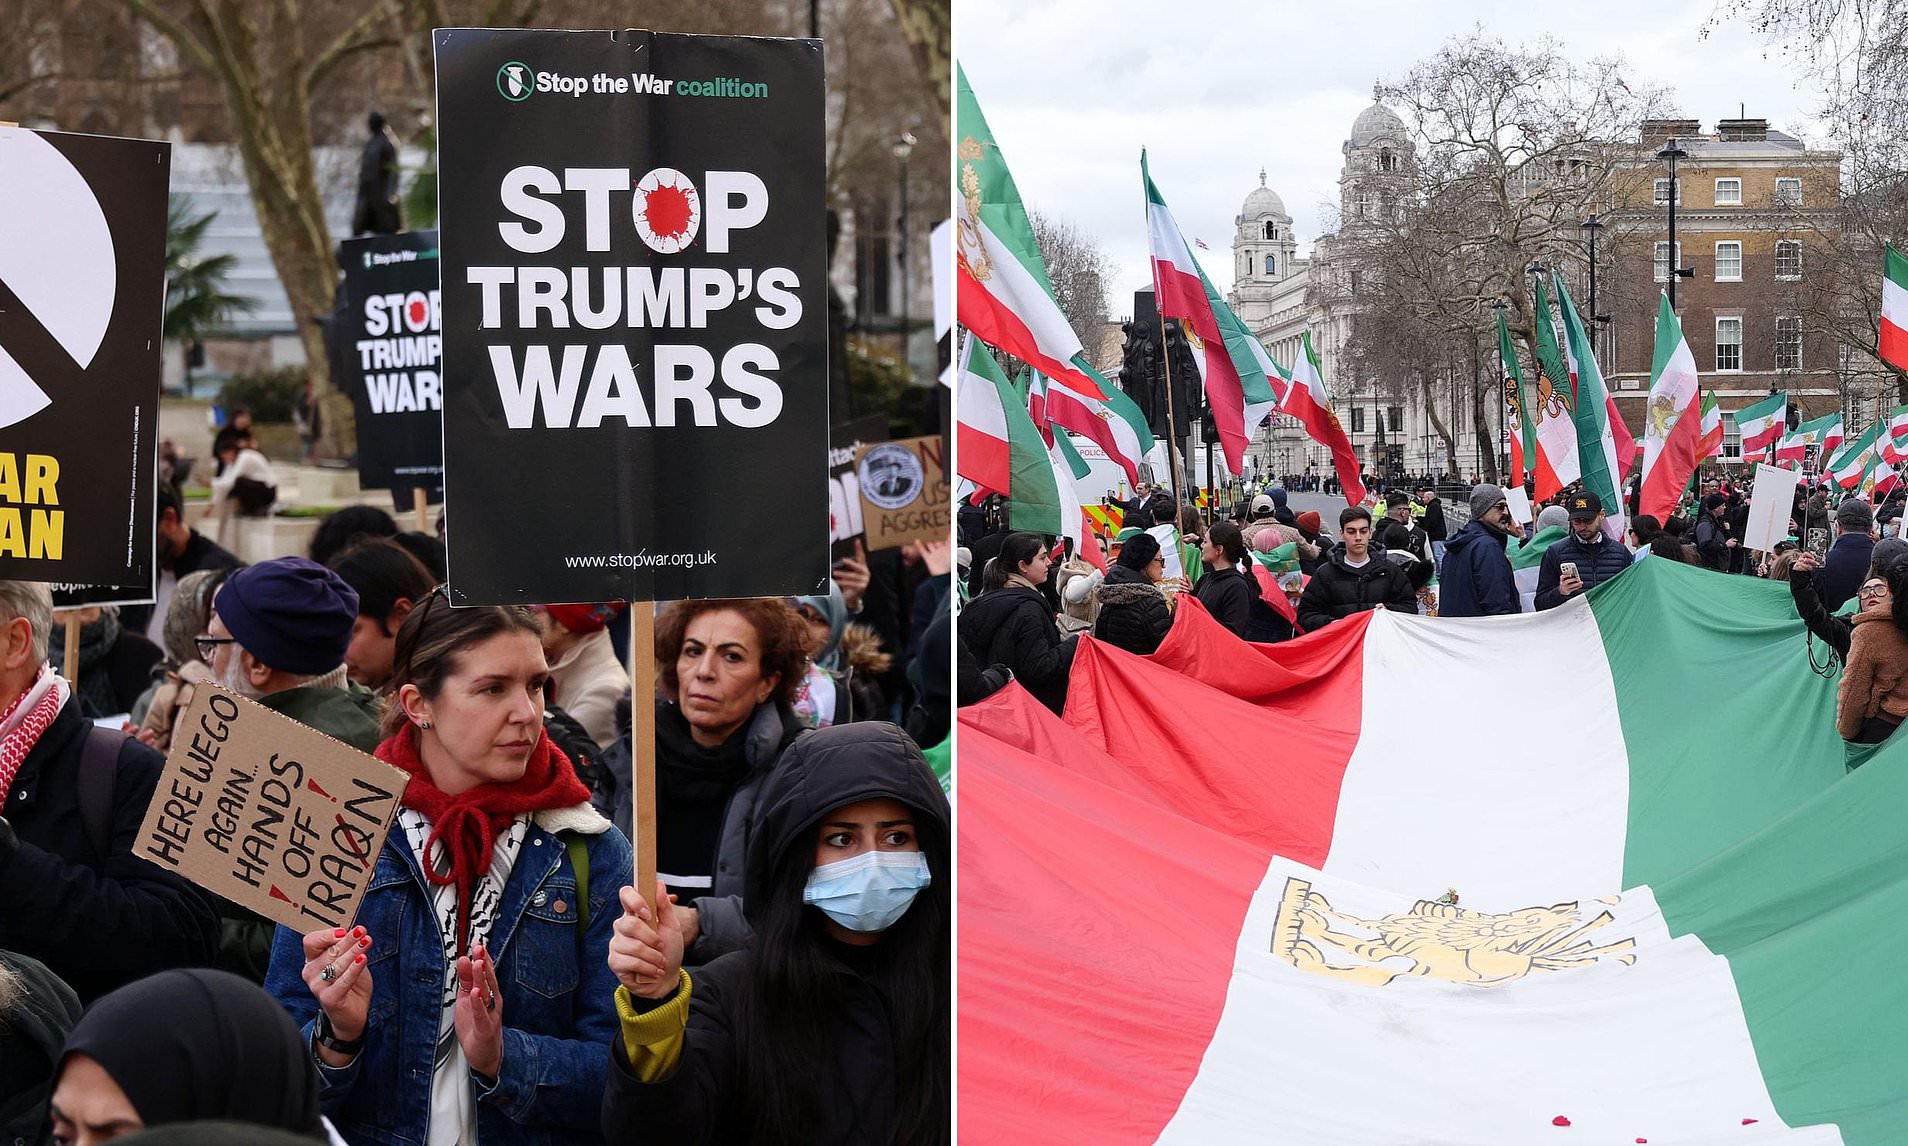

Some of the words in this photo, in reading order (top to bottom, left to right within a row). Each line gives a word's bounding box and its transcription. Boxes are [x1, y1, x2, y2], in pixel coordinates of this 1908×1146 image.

[536, 72, 588, 97] Stop
[592, 74, 628, 93] the
[632, 74, 673, 95] War
[676, 76, 768, 98] coalition
[498, 165, 769, 254] STOP
[467, 266, 803, 329] TRUMP'S
[365, 370, 442, 414] WAR
[487, 343, 784, 429] WARS
[0, 507, 65, 560] AN
[565, 550, 717, 570] www.stopwar.org.uk
[147, 778, 203, 866] HERE
[204, 765, 259, 854] AGAIN...
[232, 753, 304, 888] HANDS
[282, 807, 320, 878] OFF
